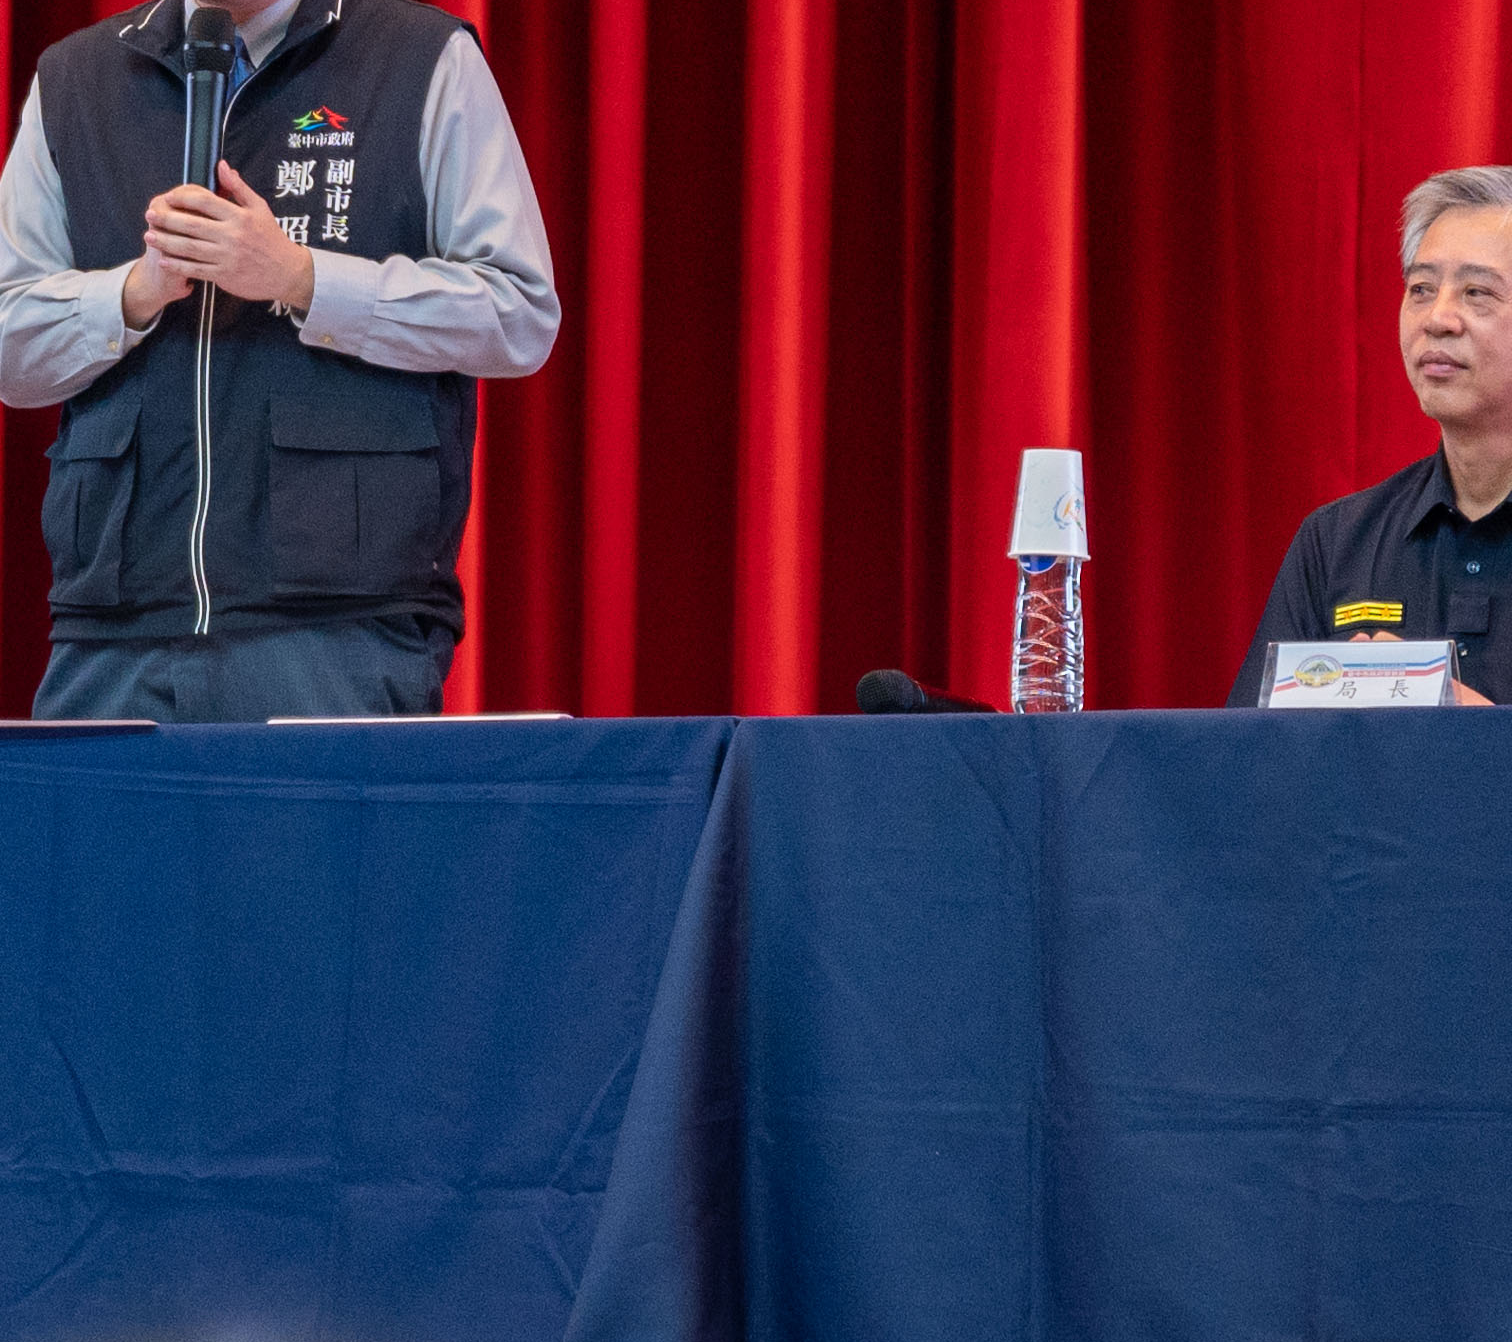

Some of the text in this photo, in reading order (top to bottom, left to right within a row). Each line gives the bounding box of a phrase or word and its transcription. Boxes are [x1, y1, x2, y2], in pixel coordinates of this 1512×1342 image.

[288, 132, 355, 148] 臺中市政府
[322, 159, 355, 243] 副市長
